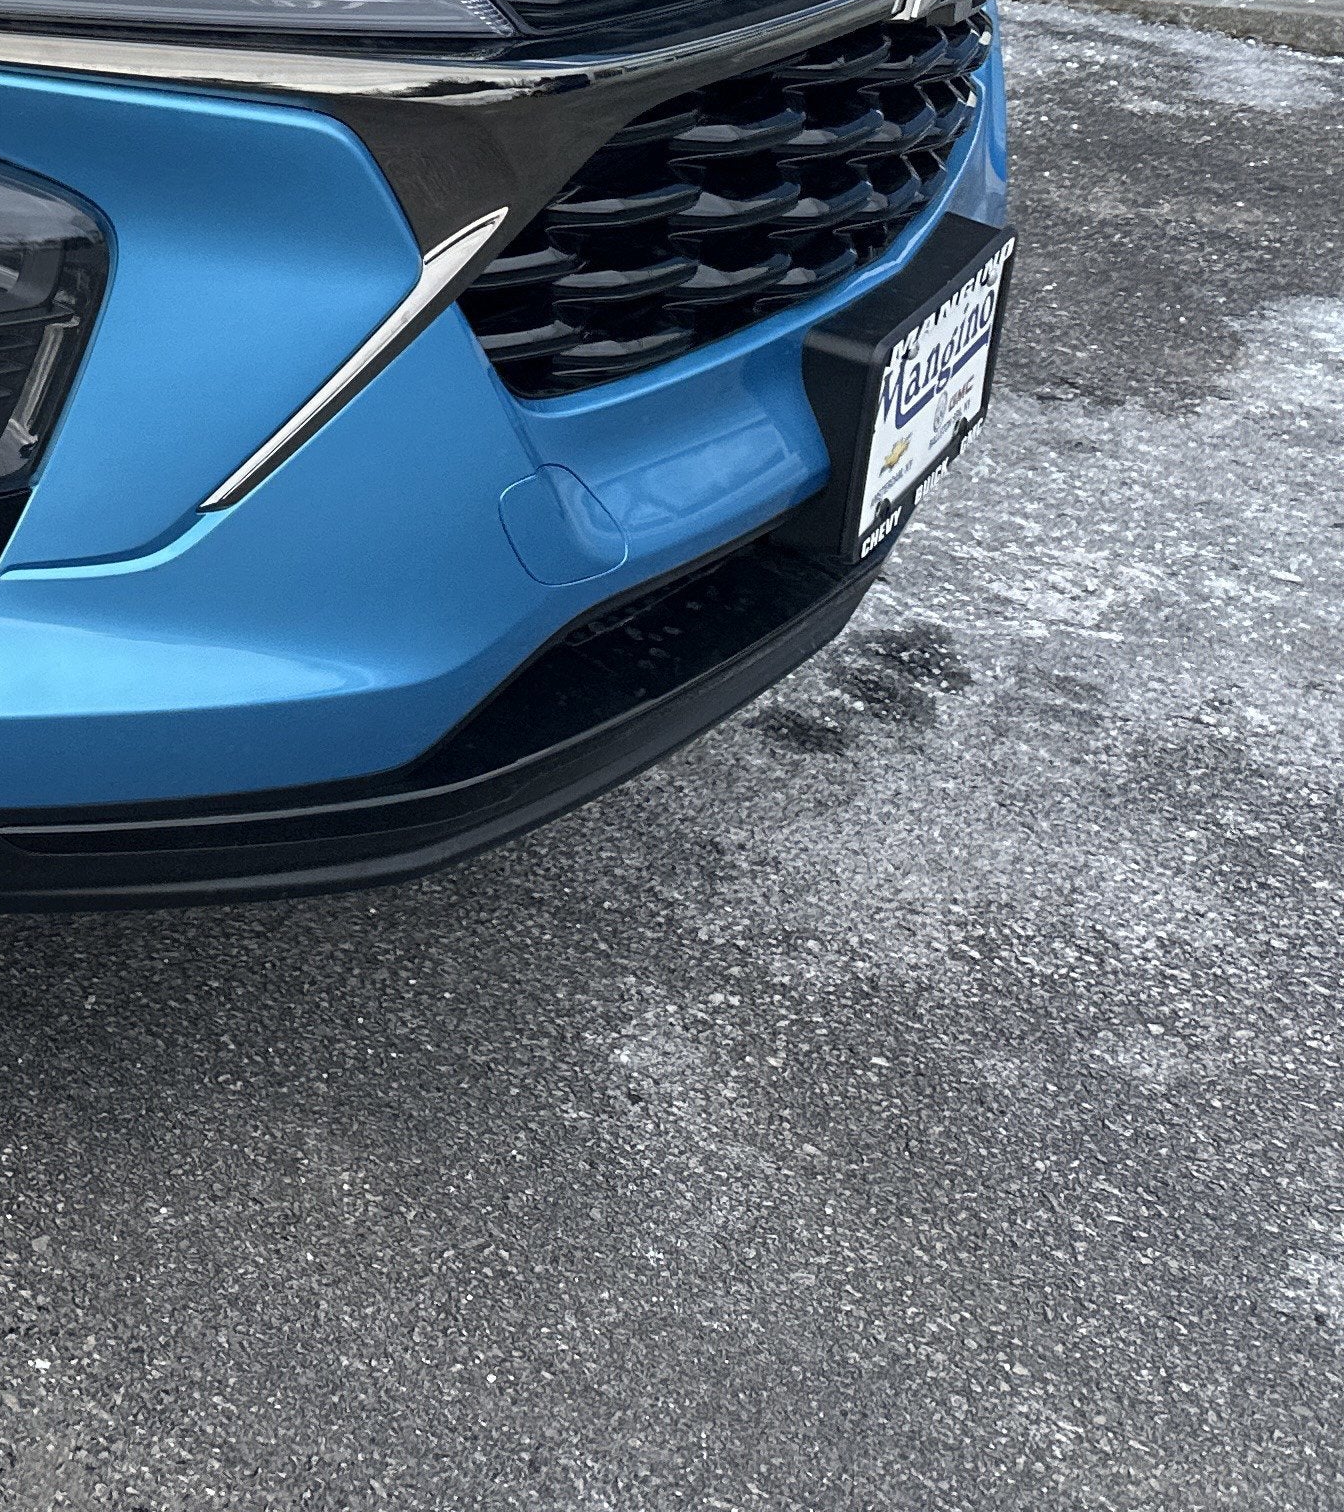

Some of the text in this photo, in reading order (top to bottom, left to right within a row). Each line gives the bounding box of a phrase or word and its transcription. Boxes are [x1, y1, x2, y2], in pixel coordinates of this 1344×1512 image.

[878, 290, 995, 430] Mangino
[860, 505, 903, 559] CHEVY
[914, 456, 949, 506] BUICK
